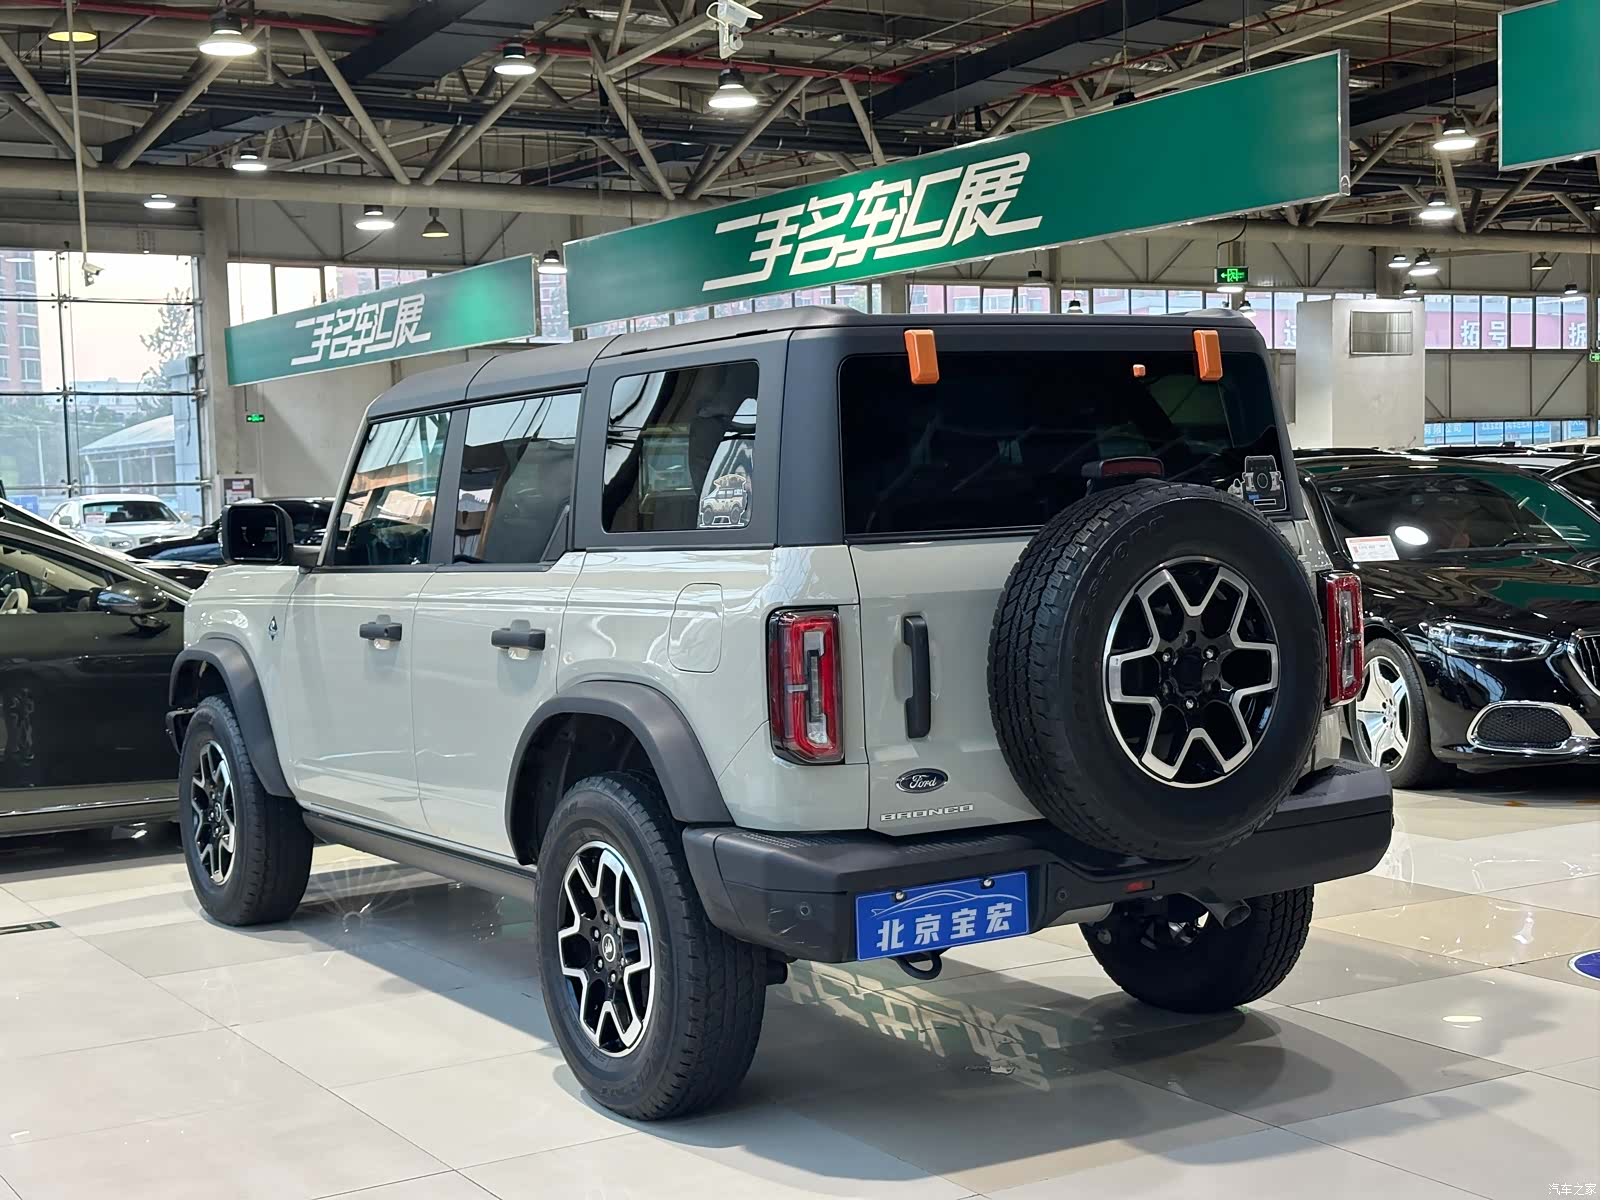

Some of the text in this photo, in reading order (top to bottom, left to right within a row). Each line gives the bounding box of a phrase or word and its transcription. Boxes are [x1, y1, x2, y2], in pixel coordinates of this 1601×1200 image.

[702, 151, 1044, 293] 二手名车汇展
[290, 292, 432, 366] 二手名车汇展
[909, 774, 937, 789] Ford
[880, 803, 974, 822] BRONCO
[876, 902, 1013, 952] 北京宝宏
